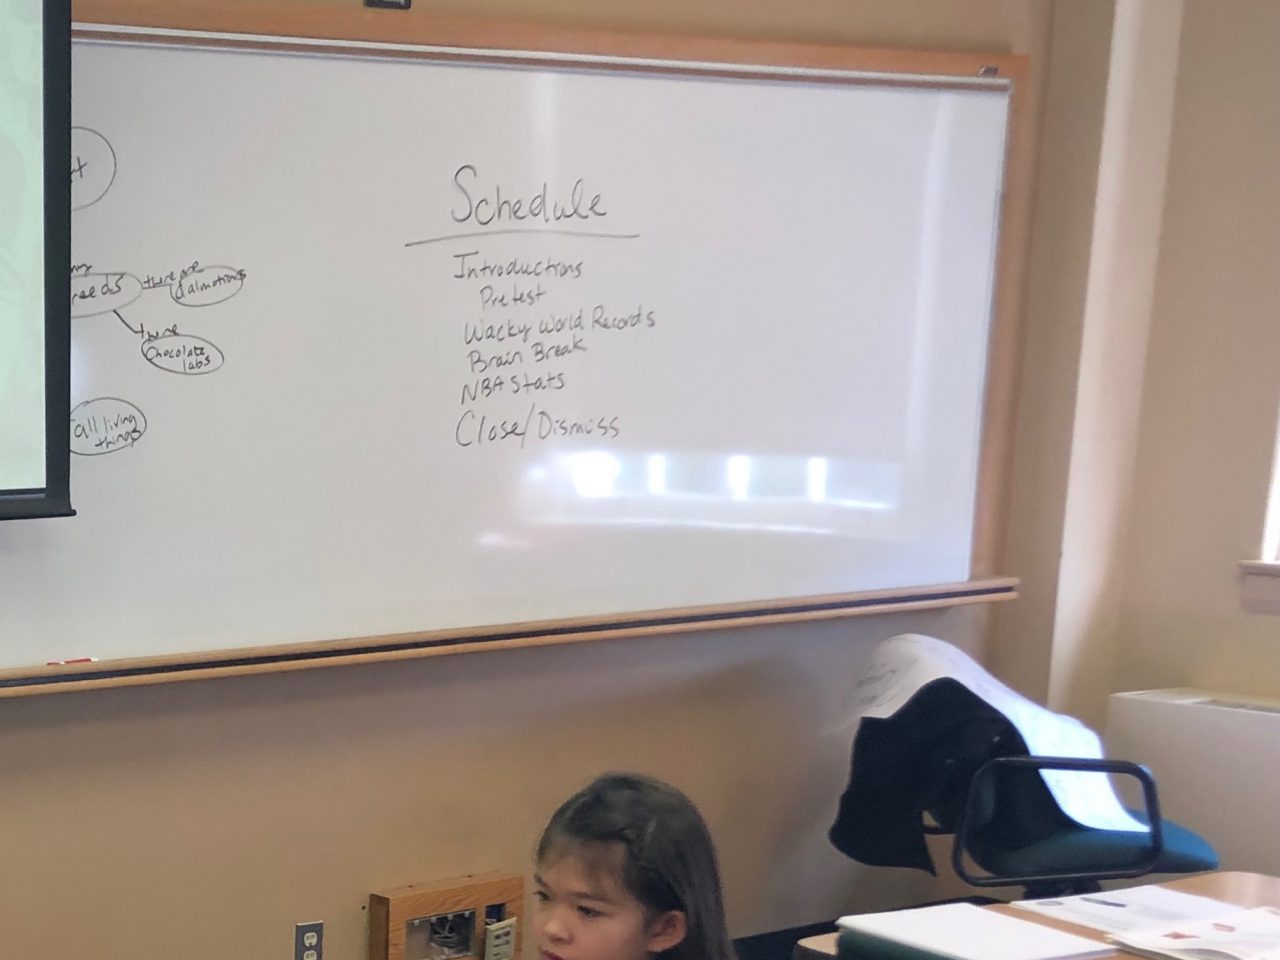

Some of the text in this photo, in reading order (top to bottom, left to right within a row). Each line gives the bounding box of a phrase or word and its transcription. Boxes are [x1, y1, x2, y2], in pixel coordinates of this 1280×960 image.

[451, 164, 607, 226] Schedule
[453, 251, 584, 280] Introductions
[71, 273, 126, 305] reeds
[464, 318, 532, 345] Wacky
[592, 304, 656, 331] Records
[467, 335, 588, 373] Brain Break
[460, 372, 566, 405] NBA Stats
[73, 413, 138, 439] all living
[455, 403, 620, 449] Close/Dismiss
